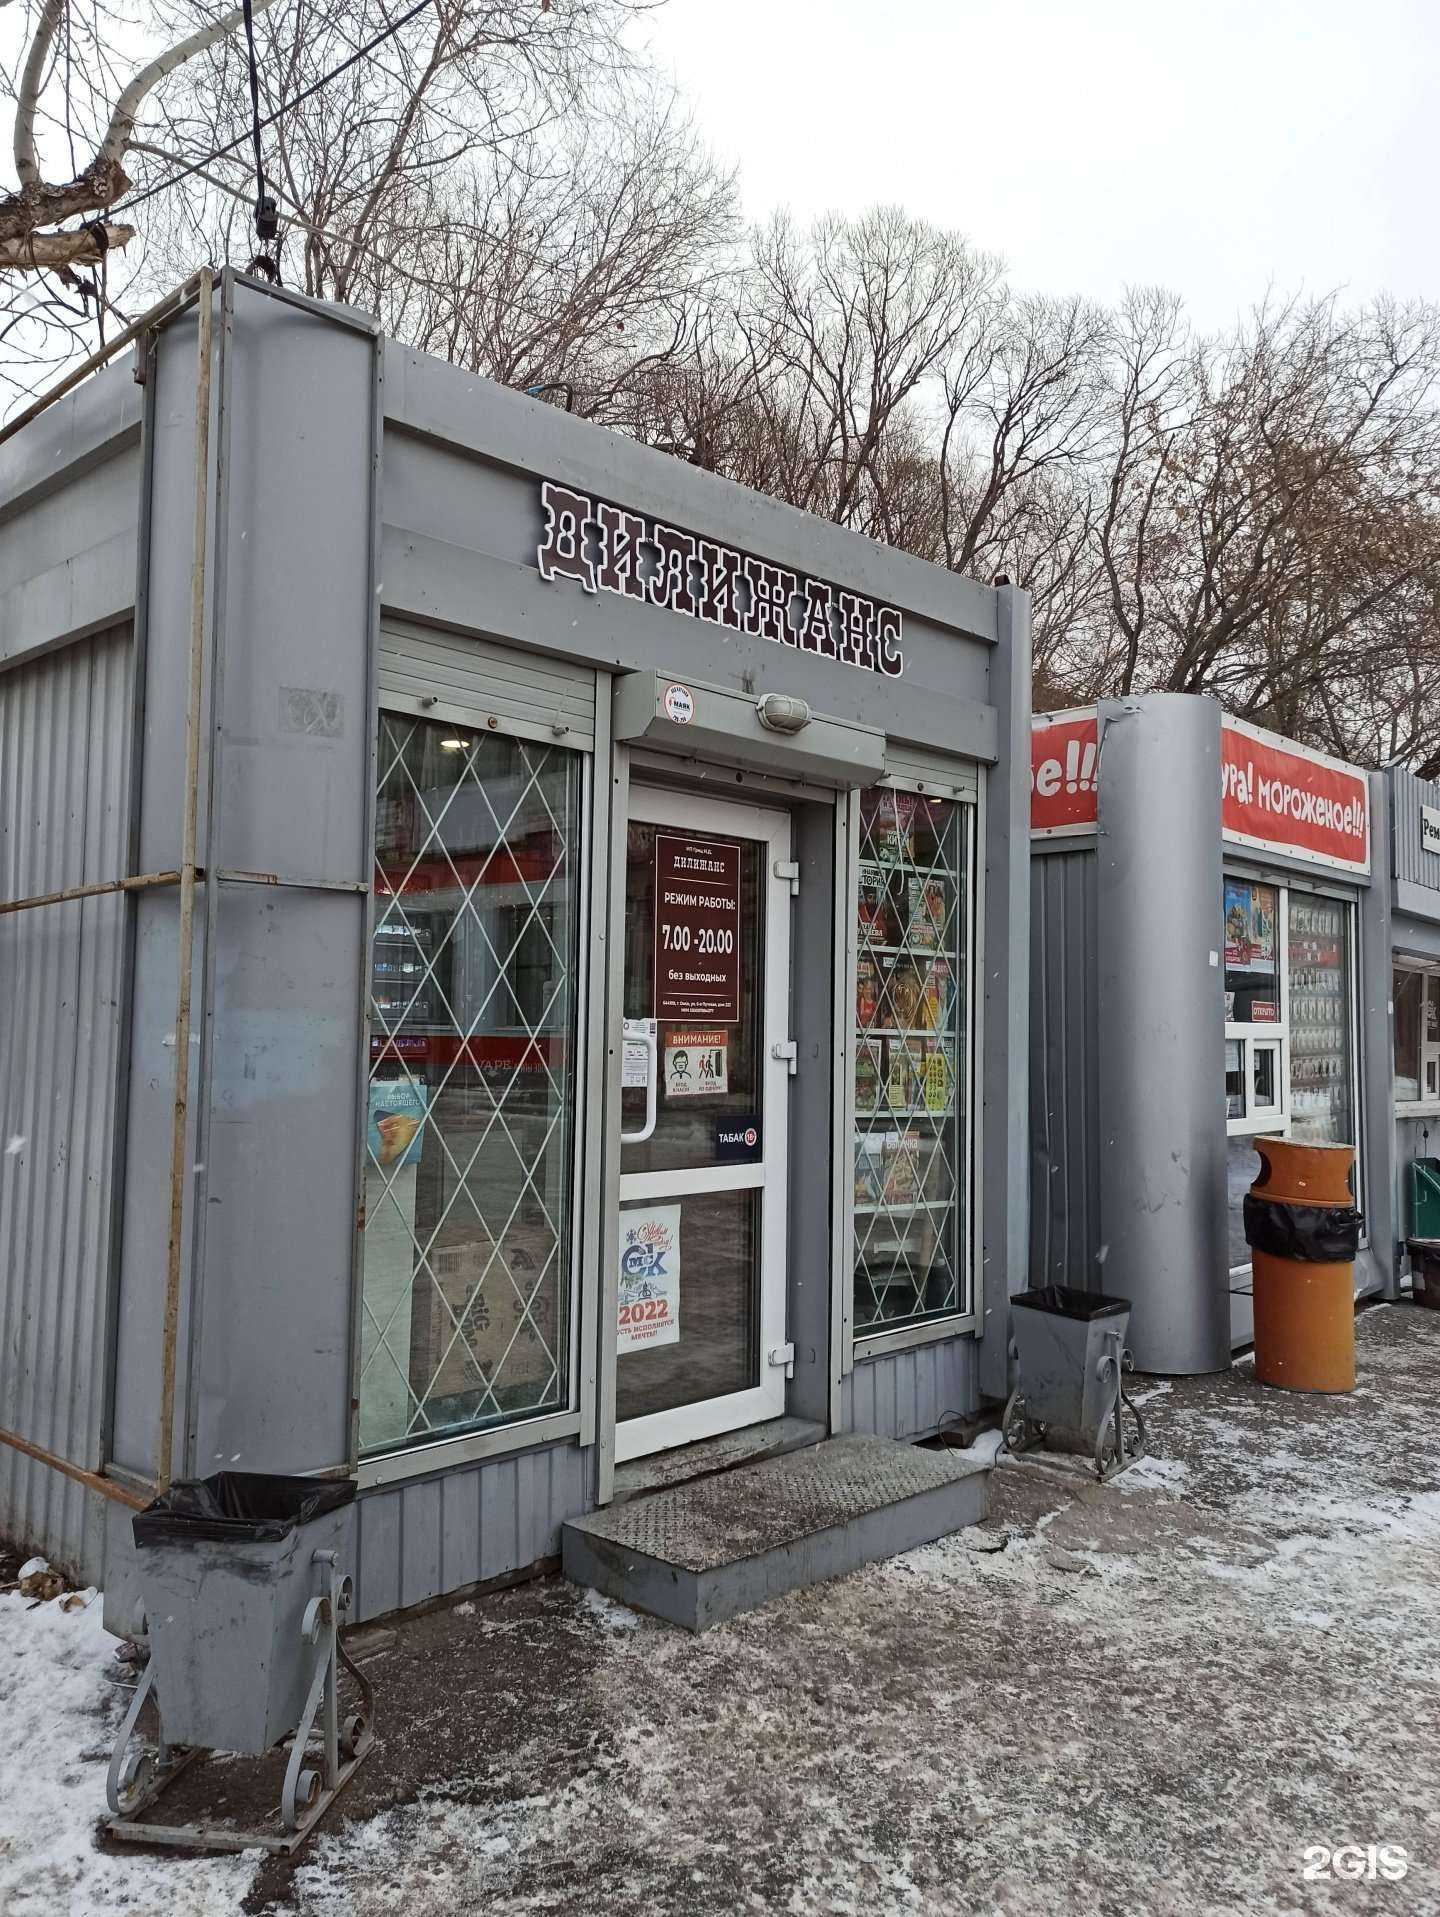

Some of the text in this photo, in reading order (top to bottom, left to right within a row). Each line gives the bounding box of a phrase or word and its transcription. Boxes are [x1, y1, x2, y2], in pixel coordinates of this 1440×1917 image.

[537, 482, 904, 679] ДИЛИЖАНС
[1031, 740, 1097, 797] е!!
[673, 856, 725, 873] ДИЛИЖАНС
[664, 892, 736, 910] РЕЖИМ РАБОТЫ:
[662, 924, 691, 952] 7.00
[668, 969, 727, 983] без выходных
[672, 1034, 721, 1045] ВНИМАНИЕ!
[718, 1132, 744, 1144] ТАБАК
[618, 1298, 668, 1325] 2022
